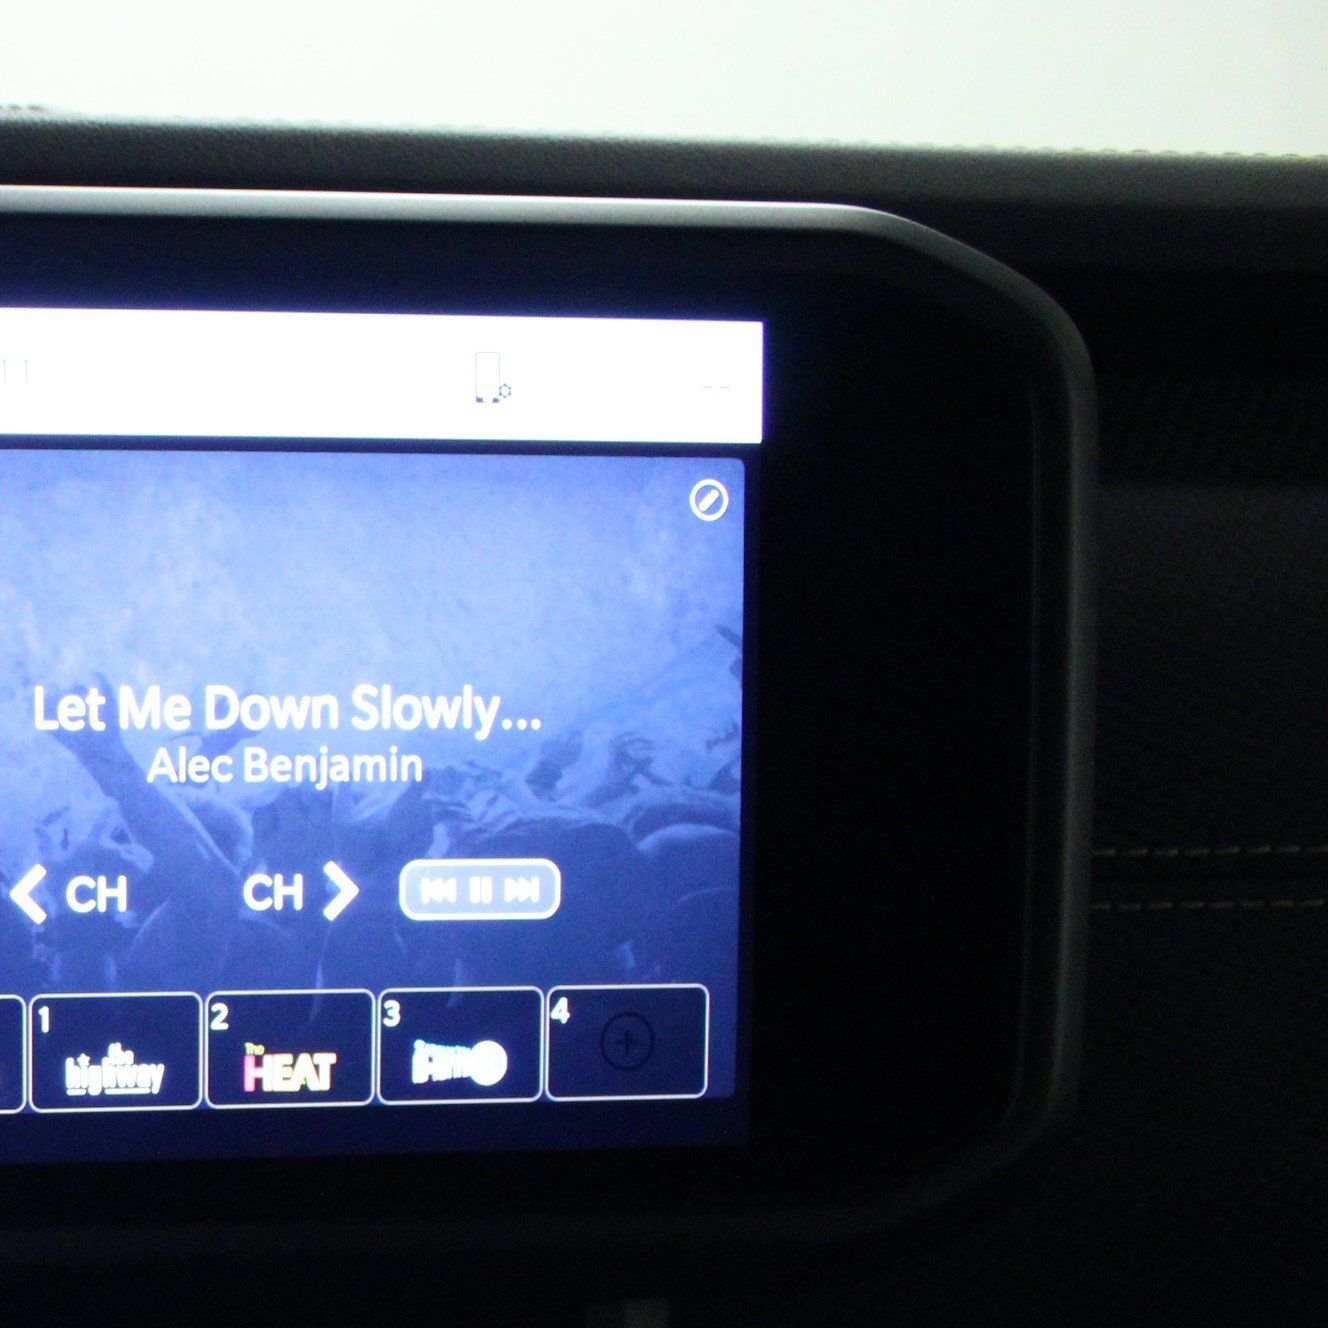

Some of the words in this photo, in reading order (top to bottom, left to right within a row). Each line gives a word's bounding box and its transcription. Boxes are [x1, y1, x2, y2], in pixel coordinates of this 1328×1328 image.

[34, 684, 107, 731] Let
[119, 684, 192, 731] Me
[204, 684, 339, 731] Down
[351, 683, 542, 741] Slowly...
[147, 746, 234, 784] Alec
[243, 745, 424, 791] Benjamin
[65, 874, 128, 913] CH
[243, 873, 304, 911] CH
[38, 1006, 50, 1033] 1
[210, 1003, 229, 1030] 2
[382, 1000, 401, 1027] 3
[550, 996, 570, 1024] 4
[244, 1053, 337, 1092] HEAT
